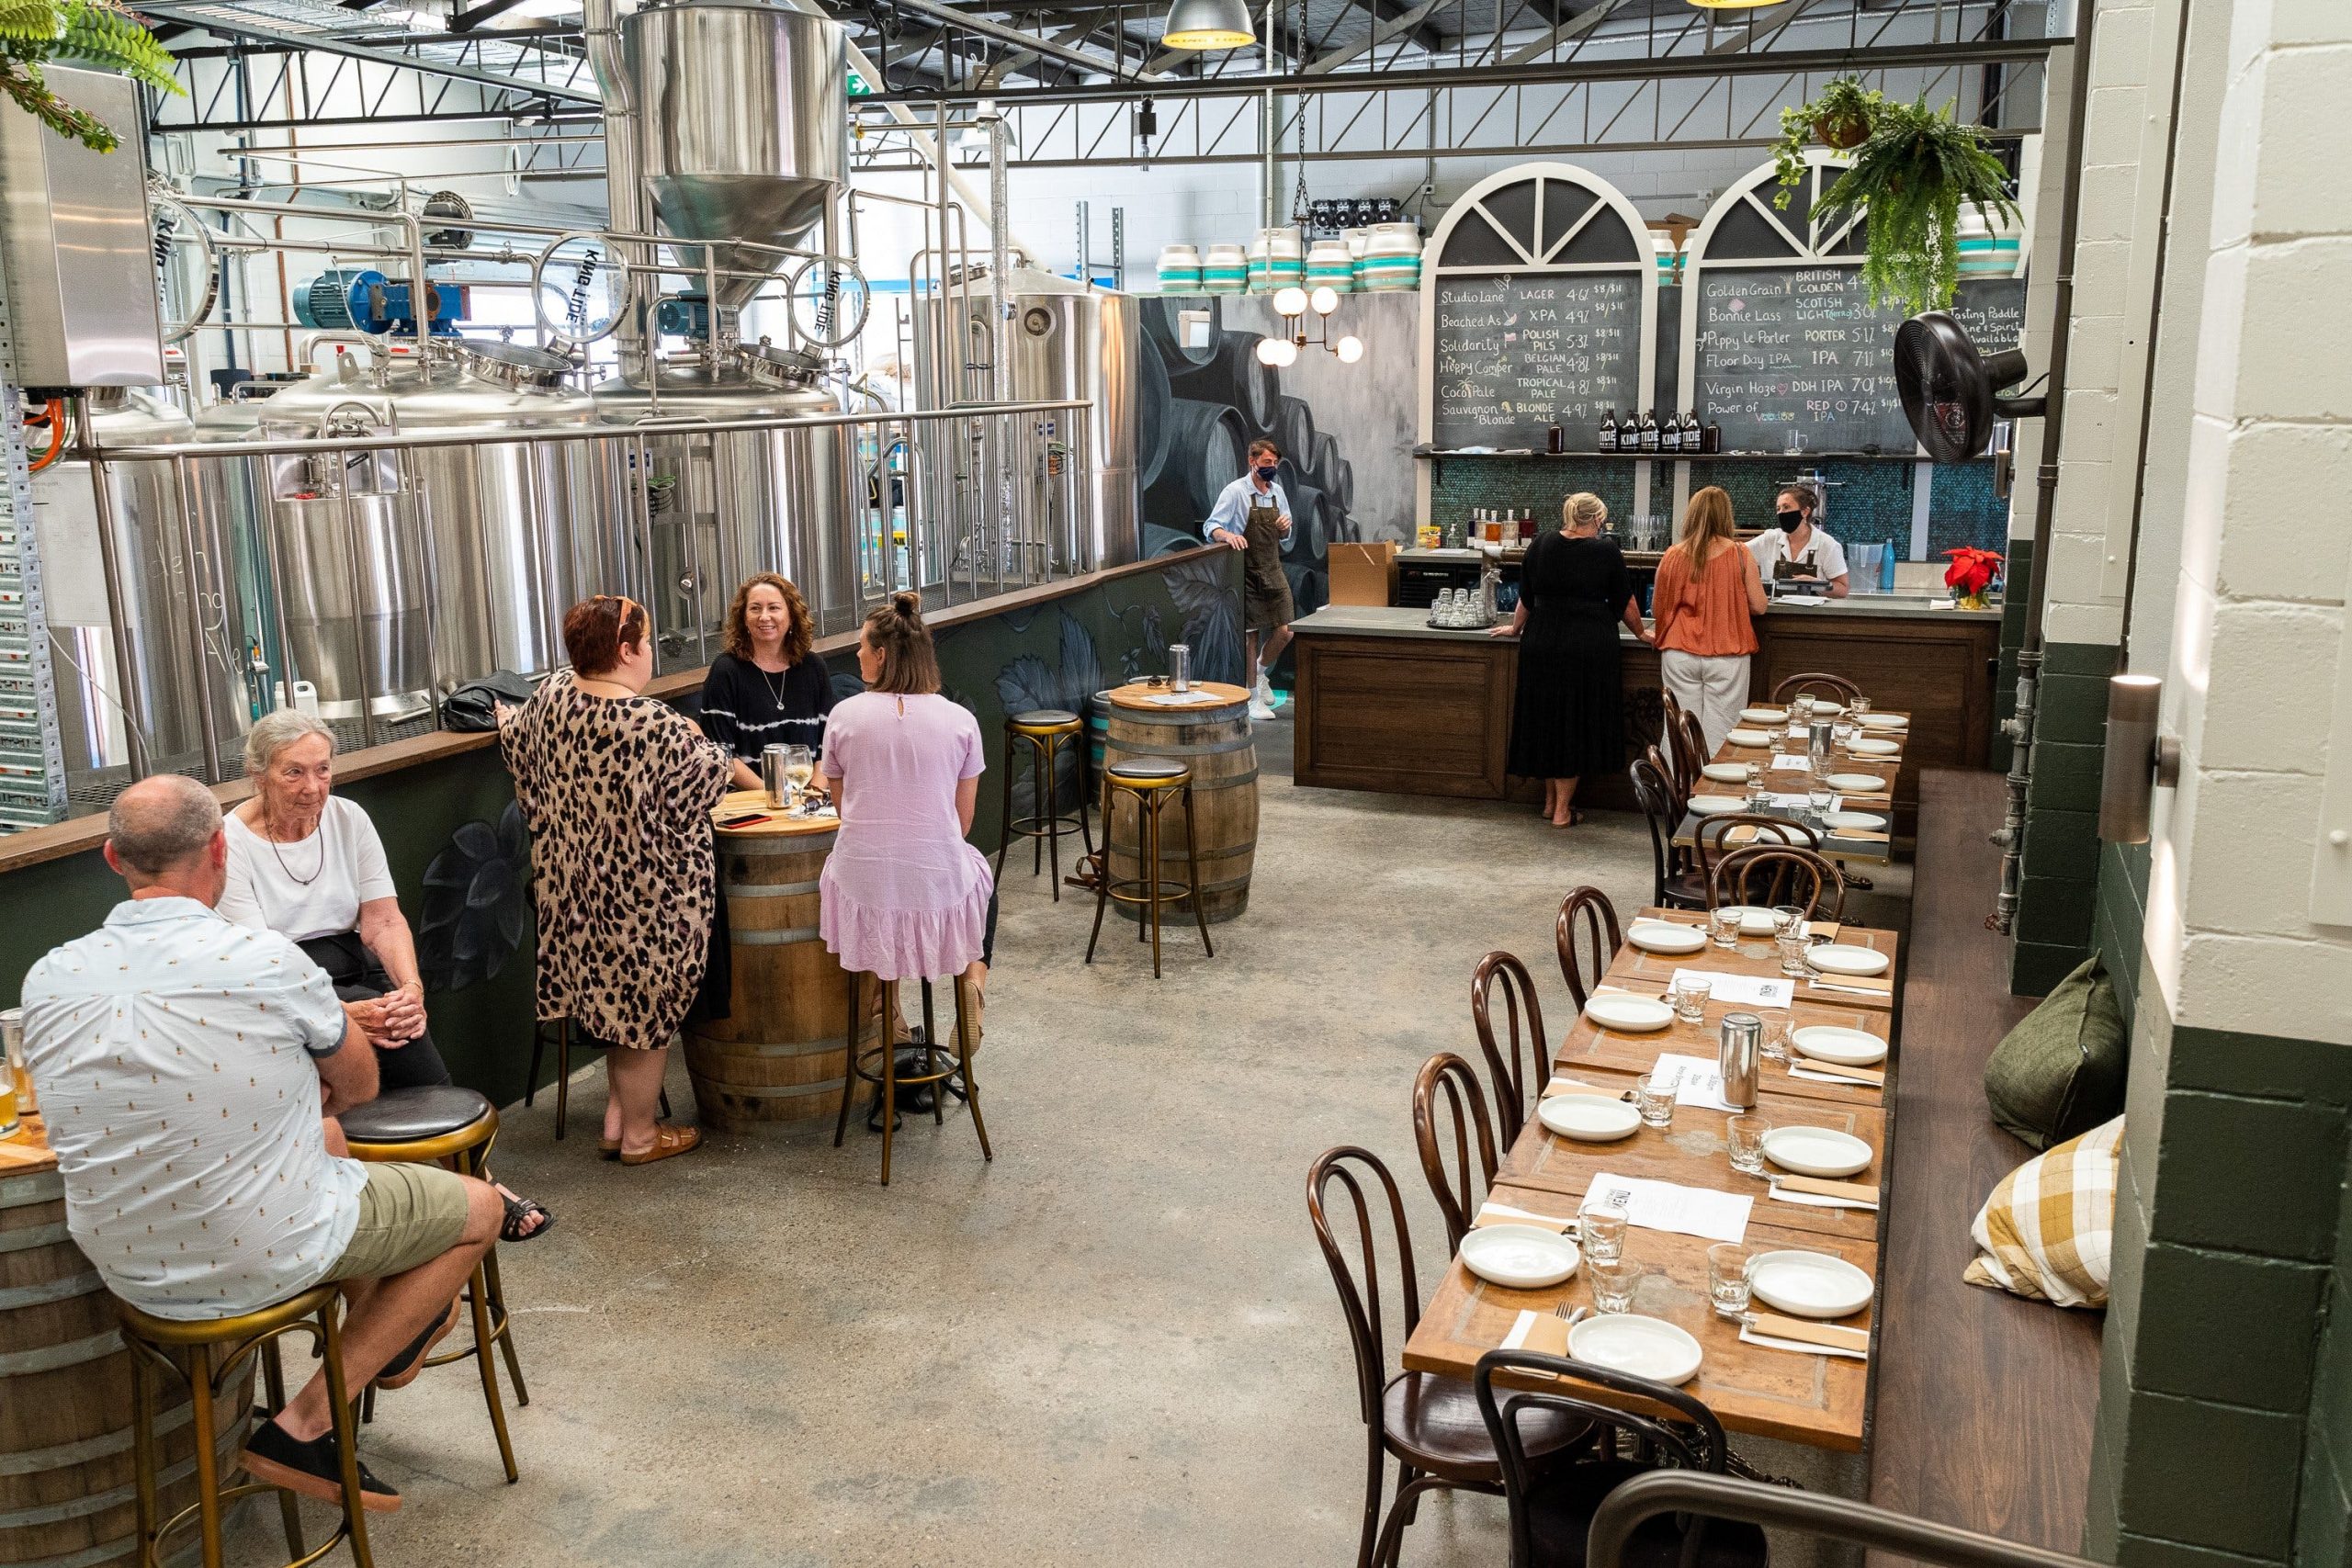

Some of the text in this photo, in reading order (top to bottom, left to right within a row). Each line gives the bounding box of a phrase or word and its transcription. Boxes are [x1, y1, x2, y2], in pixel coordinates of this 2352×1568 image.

[1795, 269, 1841, 282] BRITISH
[1706, 283, 1781, 297] Golden Grain
[1798, 282, 1844, 293] GOLDEN
[1442, 291, 1504, 303] Studio Lane
[1520, 289, 1555, 299] LAGER
[1795, 297, 1842, 309] SCOTISH
[1529, 309, 1557, 321] XPA
[1708, 307, 1781, 322] Bonnie Lass
[1949, 306, 2019, 325] Tasting Paddle
[1441, 314, 1501, 328] Beached As
[1522, 329, 1560, 340] POLISH
[1708, 331, 1740, 351] Pippy
[1758, 330, 1791, 344] Porter
[1804, 330, 1846, 341] PORTER
[1441, 338, 1499, 356] Solidarity
[1533, 341, 1556, 351] PILS
[1524, 353, 1566, 364] BELGIAN
[1706, 353, 1792, 369] Floor Day IPA
[1812, 350, 1839, 365] IPA
[1475, 359, 1513, 377] Camper
[1536, 364, 1563, 374] PALE
[1516, 378, 1566, 388] TROPICAL
[1705, 380, 1776, 398] Virgin Haze
[1792, 378, 1843, 392] DDH IPA
[1441, 385, 1495, 398] Coco Pale
[1531, 389, 1556, 399] PALE
[1442, 403, 1498, 419] Sauvignon
[1516, 402, 1555, 412] BLONDE
[1708, 401, 1759, 414] Power of
[1806, 400, 1830, 412] RED
[1478, 414, 1515, 425] Blonde
[1533, 413, 1555, 423] ALE
[1814, 411, 1836, 422] IPA
